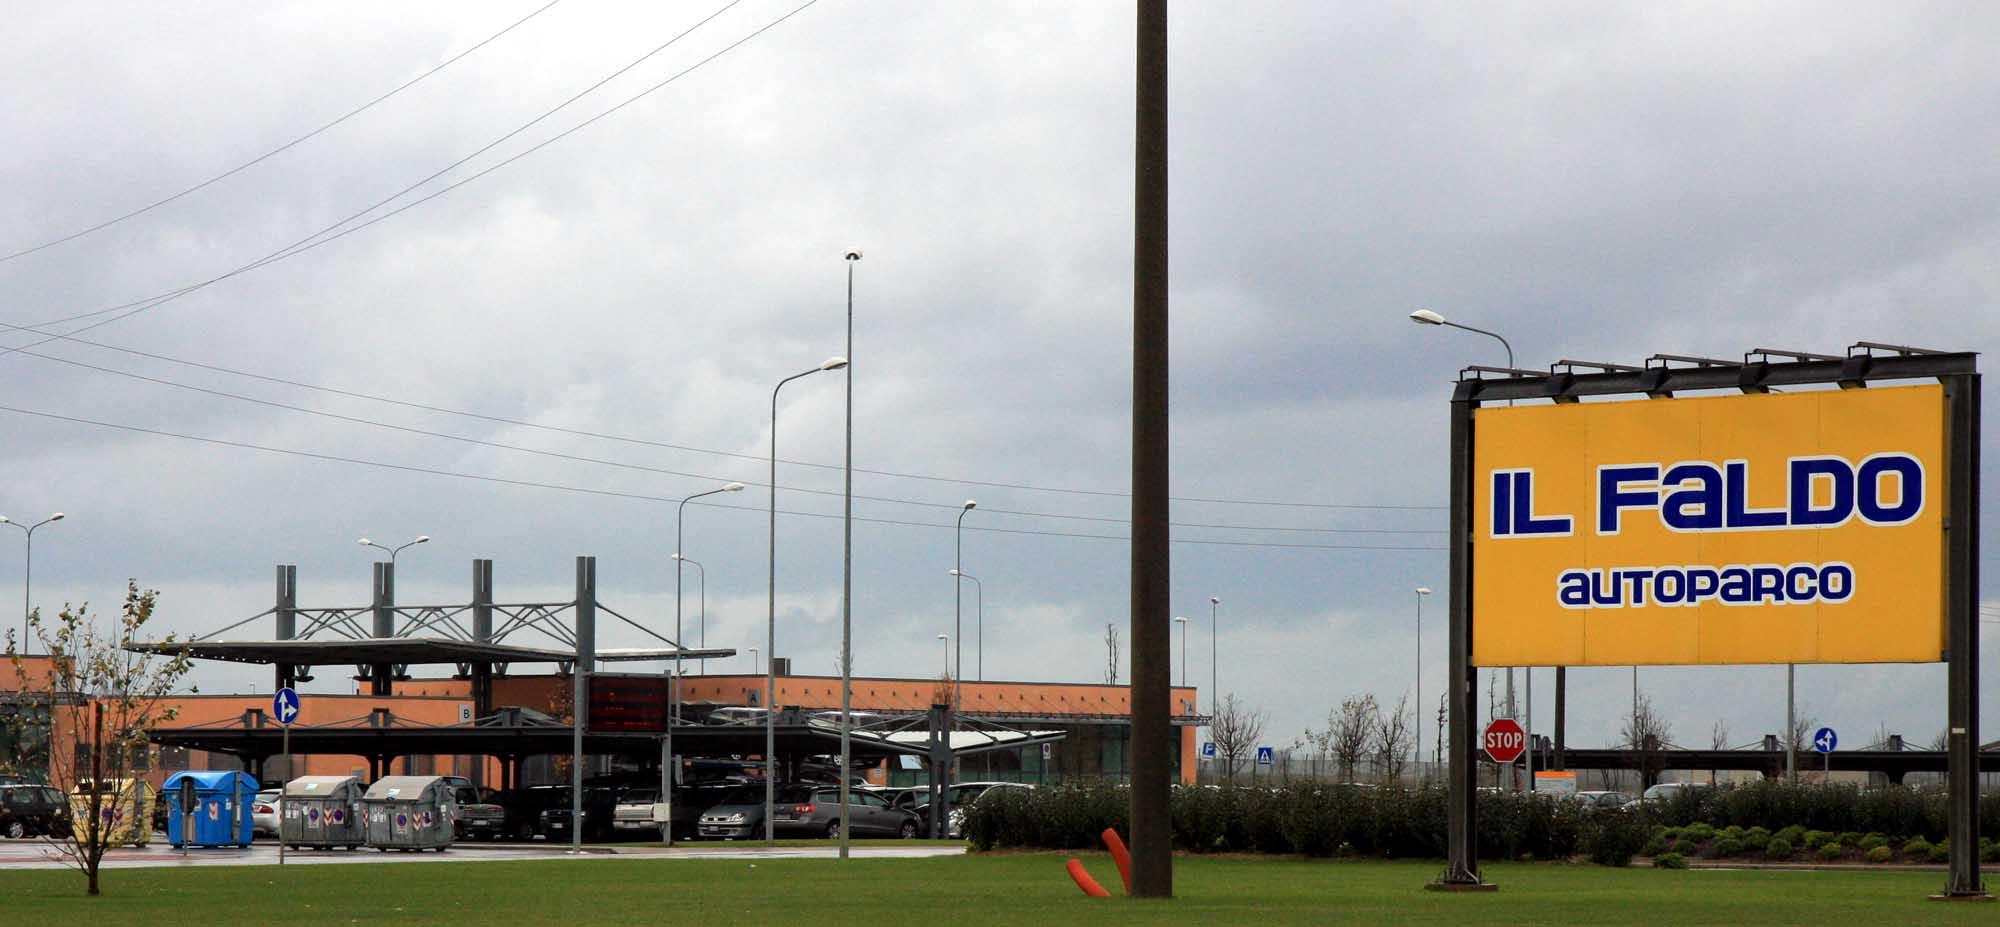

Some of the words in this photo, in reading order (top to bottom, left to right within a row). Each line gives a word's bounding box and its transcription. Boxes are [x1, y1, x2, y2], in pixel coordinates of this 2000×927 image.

[1491, 470, 1573, 538] IL
[464, 709, 470, 718] B
[1487, 732, 1522, 748] STOP
[1205, 744, 1213, 753] P
